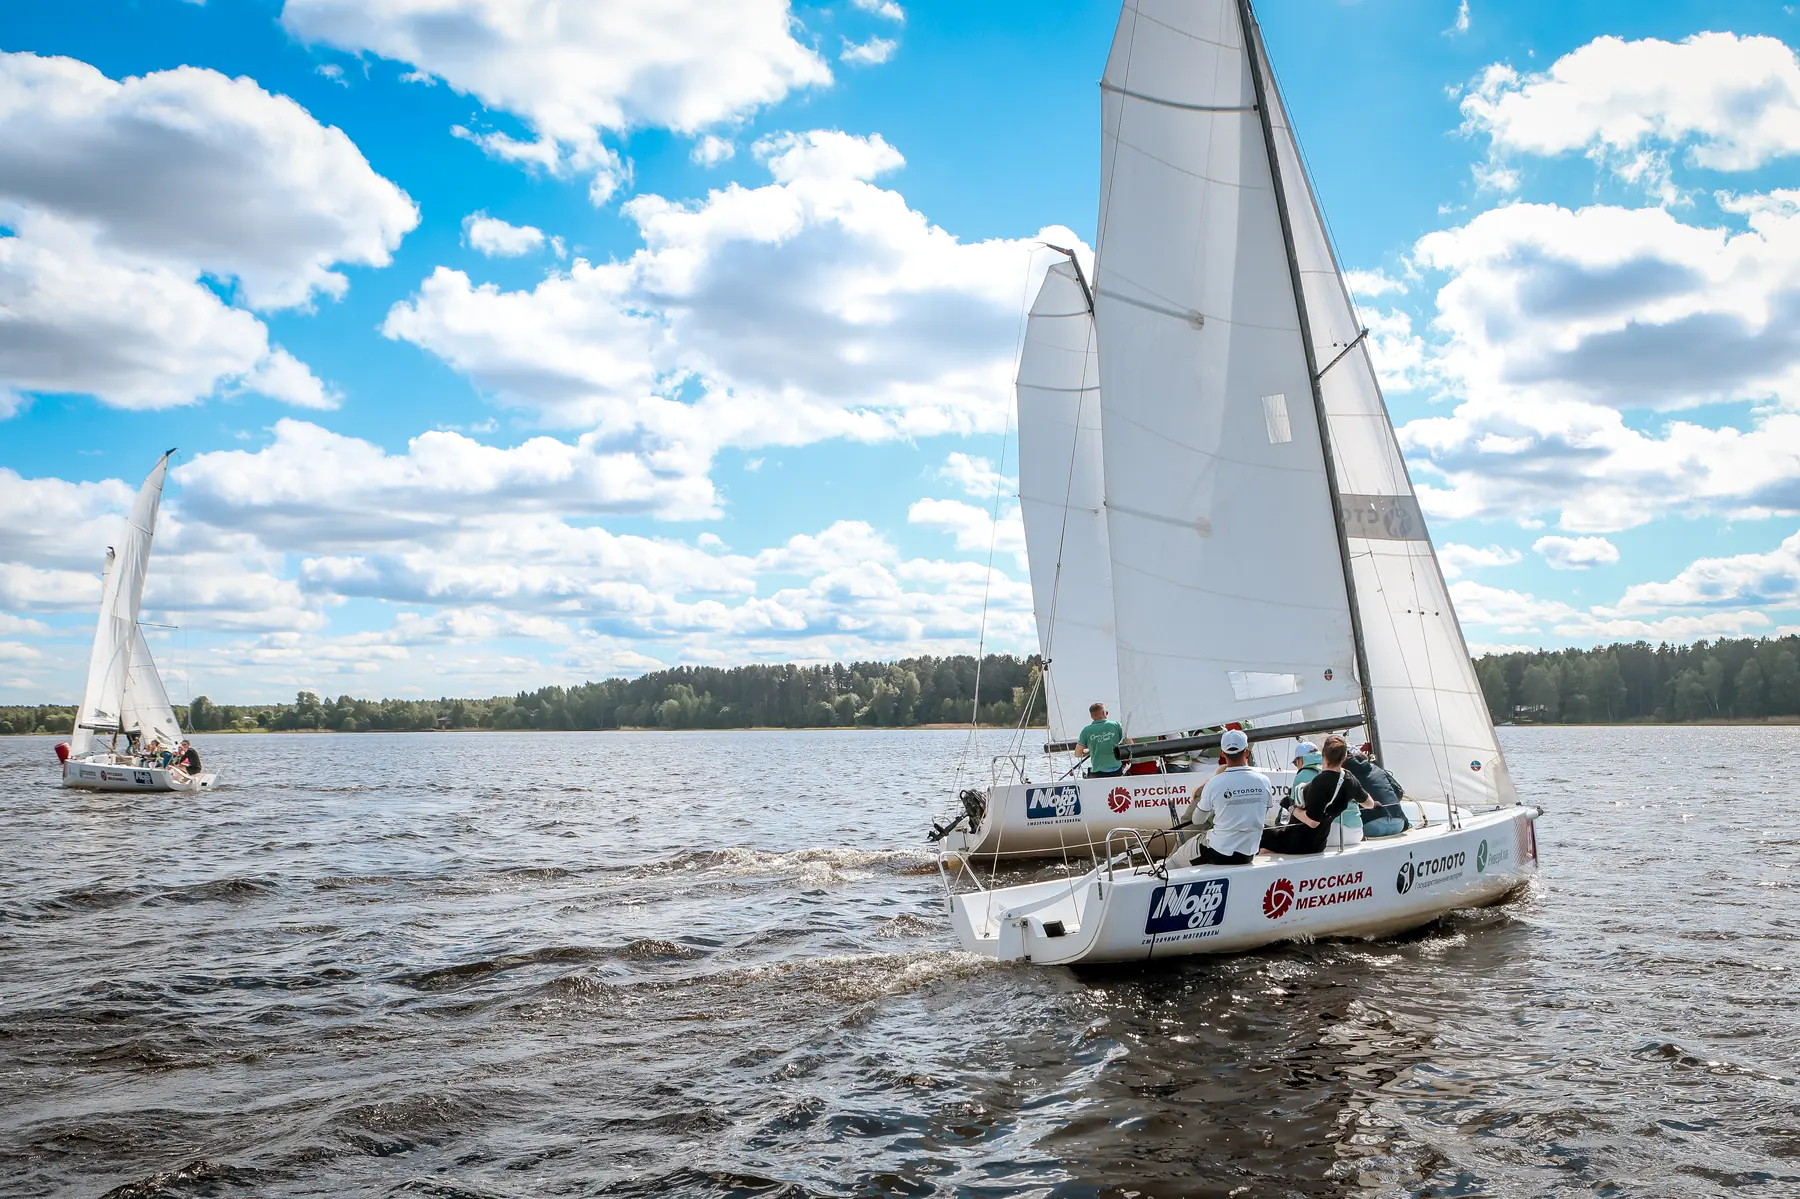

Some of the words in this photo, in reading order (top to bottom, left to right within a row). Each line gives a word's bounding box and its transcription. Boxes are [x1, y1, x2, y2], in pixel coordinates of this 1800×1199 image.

[1030, 788, 1078, 808] NORD
[1134, 786, 1187, 796] РУССКАЯ
[1056, 805, 1076, 817] OIL
[1134, 796, 1191, 809] МЕХАНИК
[1416, 851, 1466, 877] СТОЛОТО
[1298, 871, 1364, 892] РУССКАЯ
[1152, 884, 1223, 919] NORD
[1296, 886, 1373, 910] МЕХАНИКА
[1188, 910, 1216, 928] OIL
[1142, 936, 1180, 945] смзочные
